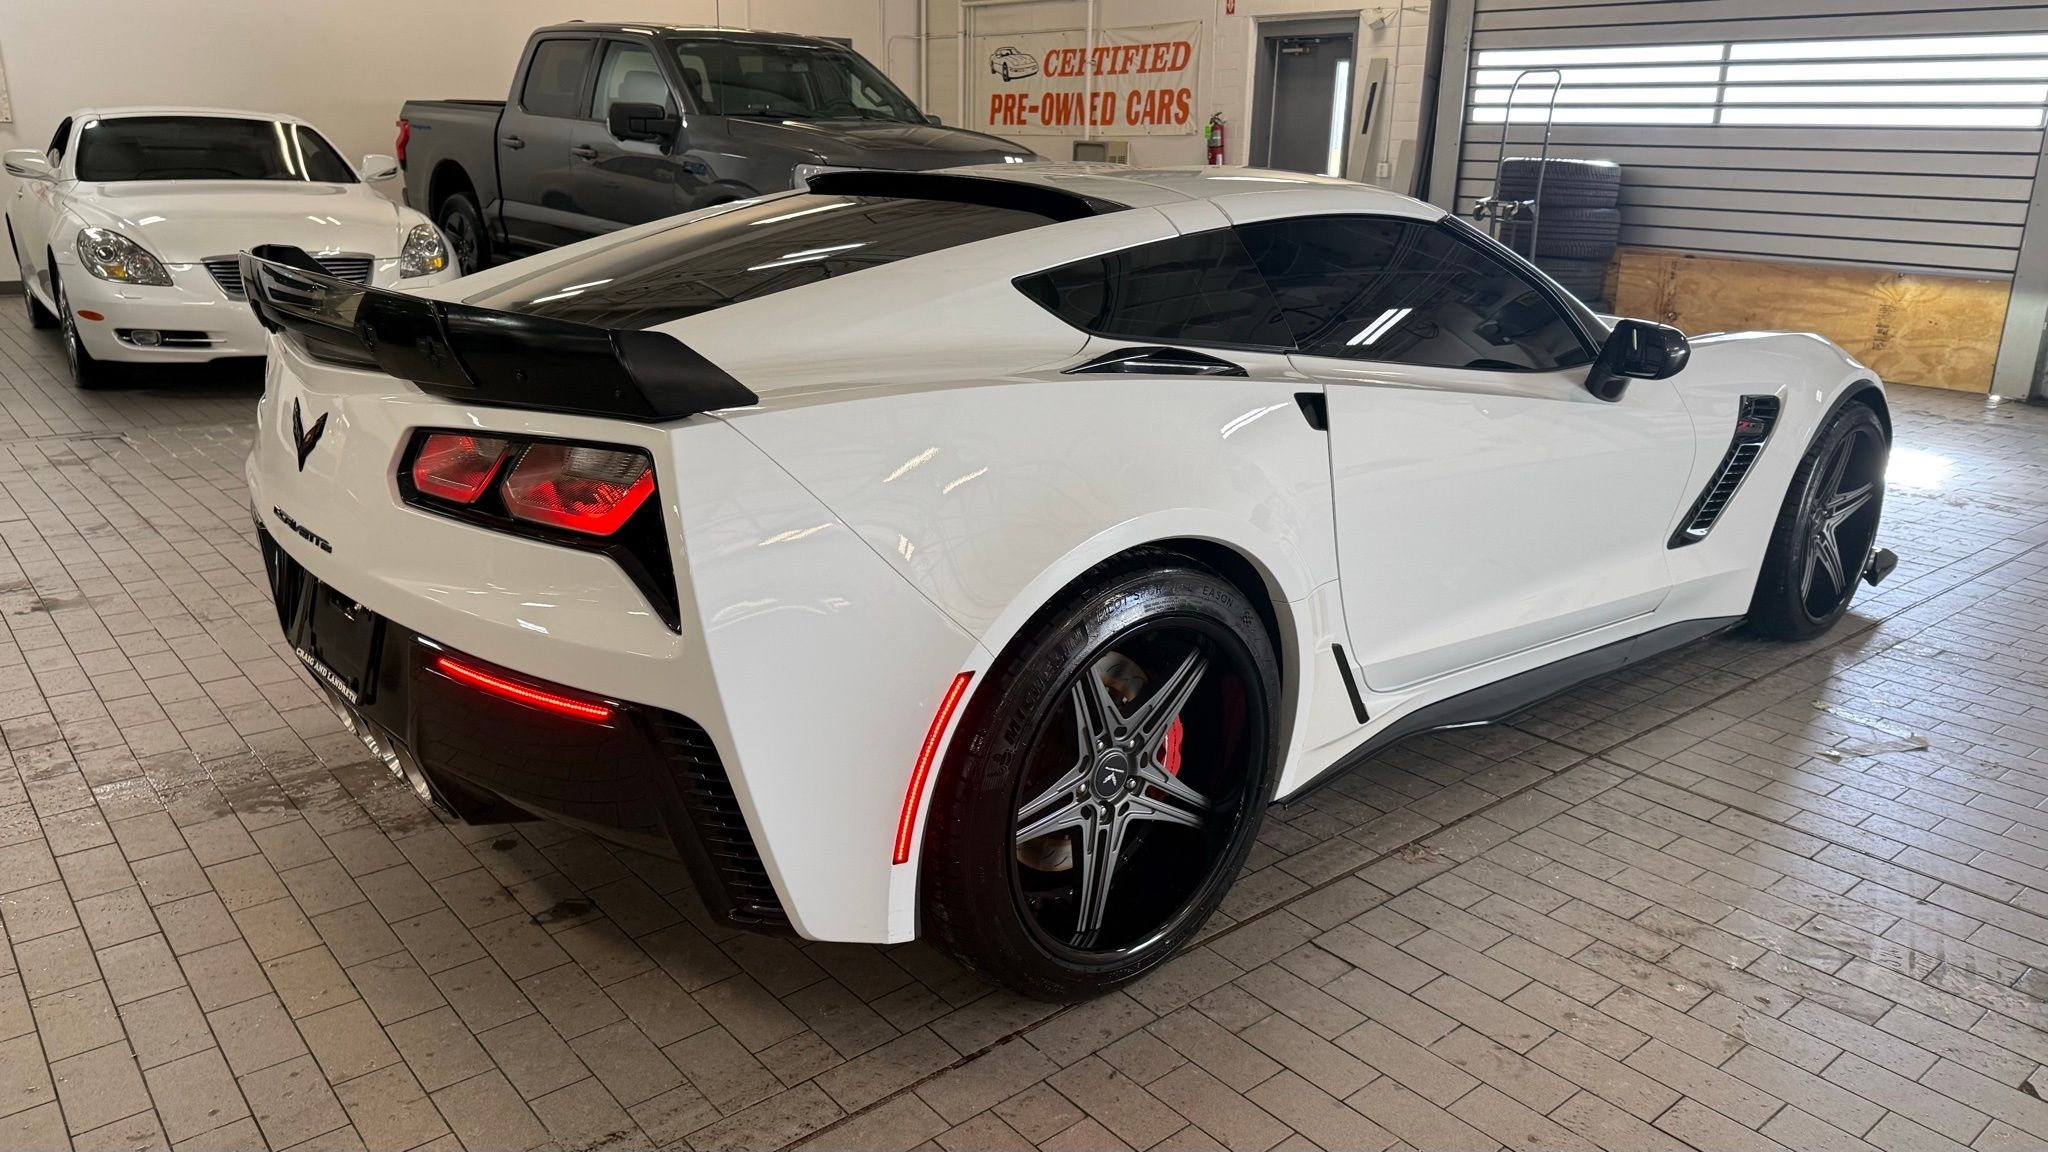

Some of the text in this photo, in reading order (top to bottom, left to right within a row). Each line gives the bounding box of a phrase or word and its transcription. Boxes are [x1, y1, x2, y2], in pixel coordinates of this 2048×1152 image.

[1044, 40, 1192, 78] CERTIFIED
[989, 87, 1192, 126] PRE-OWNED CARS
[1197, 584, 1234, 608] EASON
[296, 647, 358, 704] CRAIG AND LANDRETH
